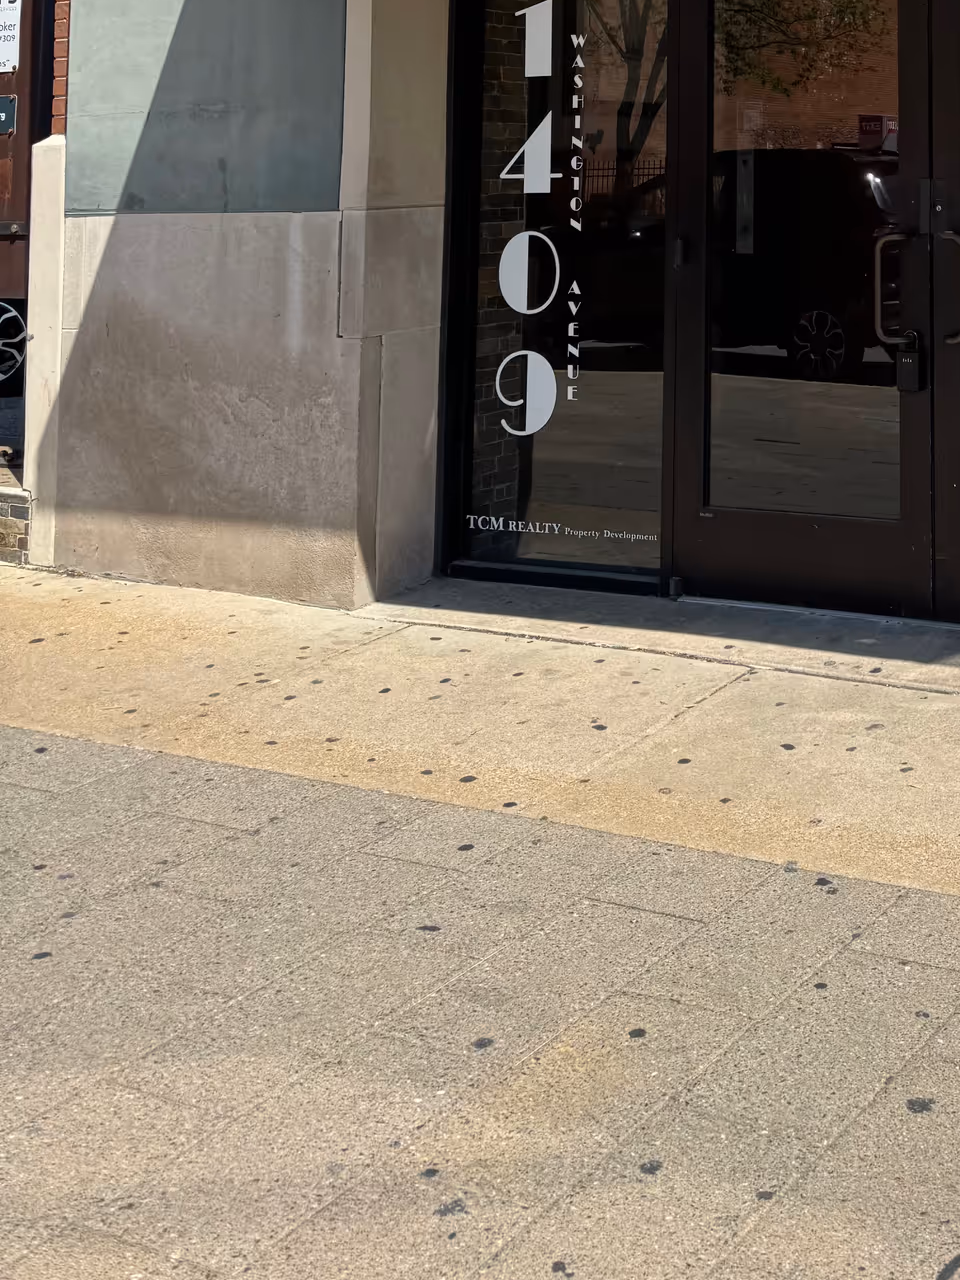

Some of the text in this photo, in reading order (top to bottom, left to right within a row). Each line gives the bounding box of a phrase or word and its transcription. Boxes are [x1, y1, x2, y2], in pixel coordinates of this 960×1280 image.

[567, 34, 587, 401] WASHINGTON AVENUE
[466, 514, 658, 542] TCM REALTY Property Development
